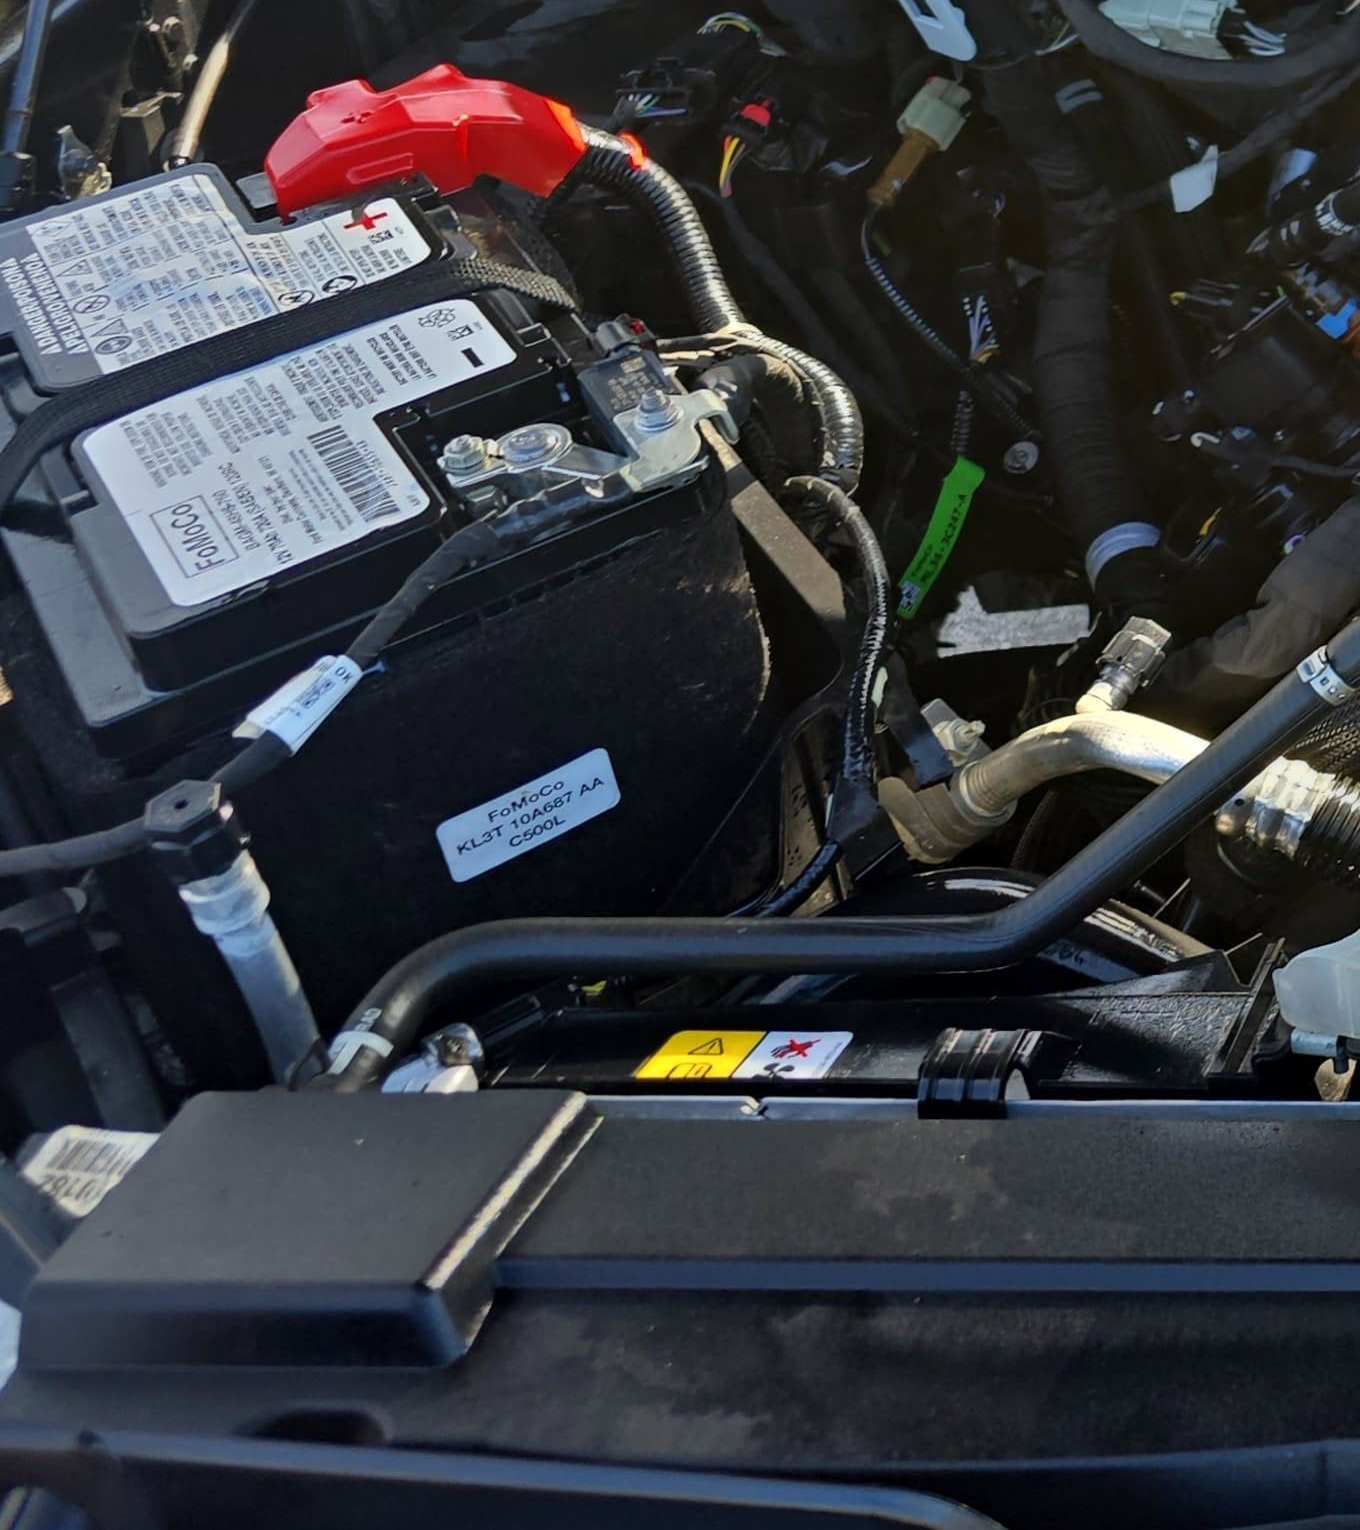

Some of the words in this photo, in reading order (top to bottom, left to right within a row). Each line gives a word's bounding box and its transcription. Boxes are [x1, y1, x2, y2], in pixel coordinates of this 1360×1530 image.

[170, 504, 225, 571] FoMoCo
[335, 666, 353, 684] OK
[457, 824, 504, 855] KL3T
[511, 790, 573, 829] 10A687
[579, 777, 604, 796] AA
[488, 781, 565, 823] FoMoCo
[509, 815, 567, 848] C500L
